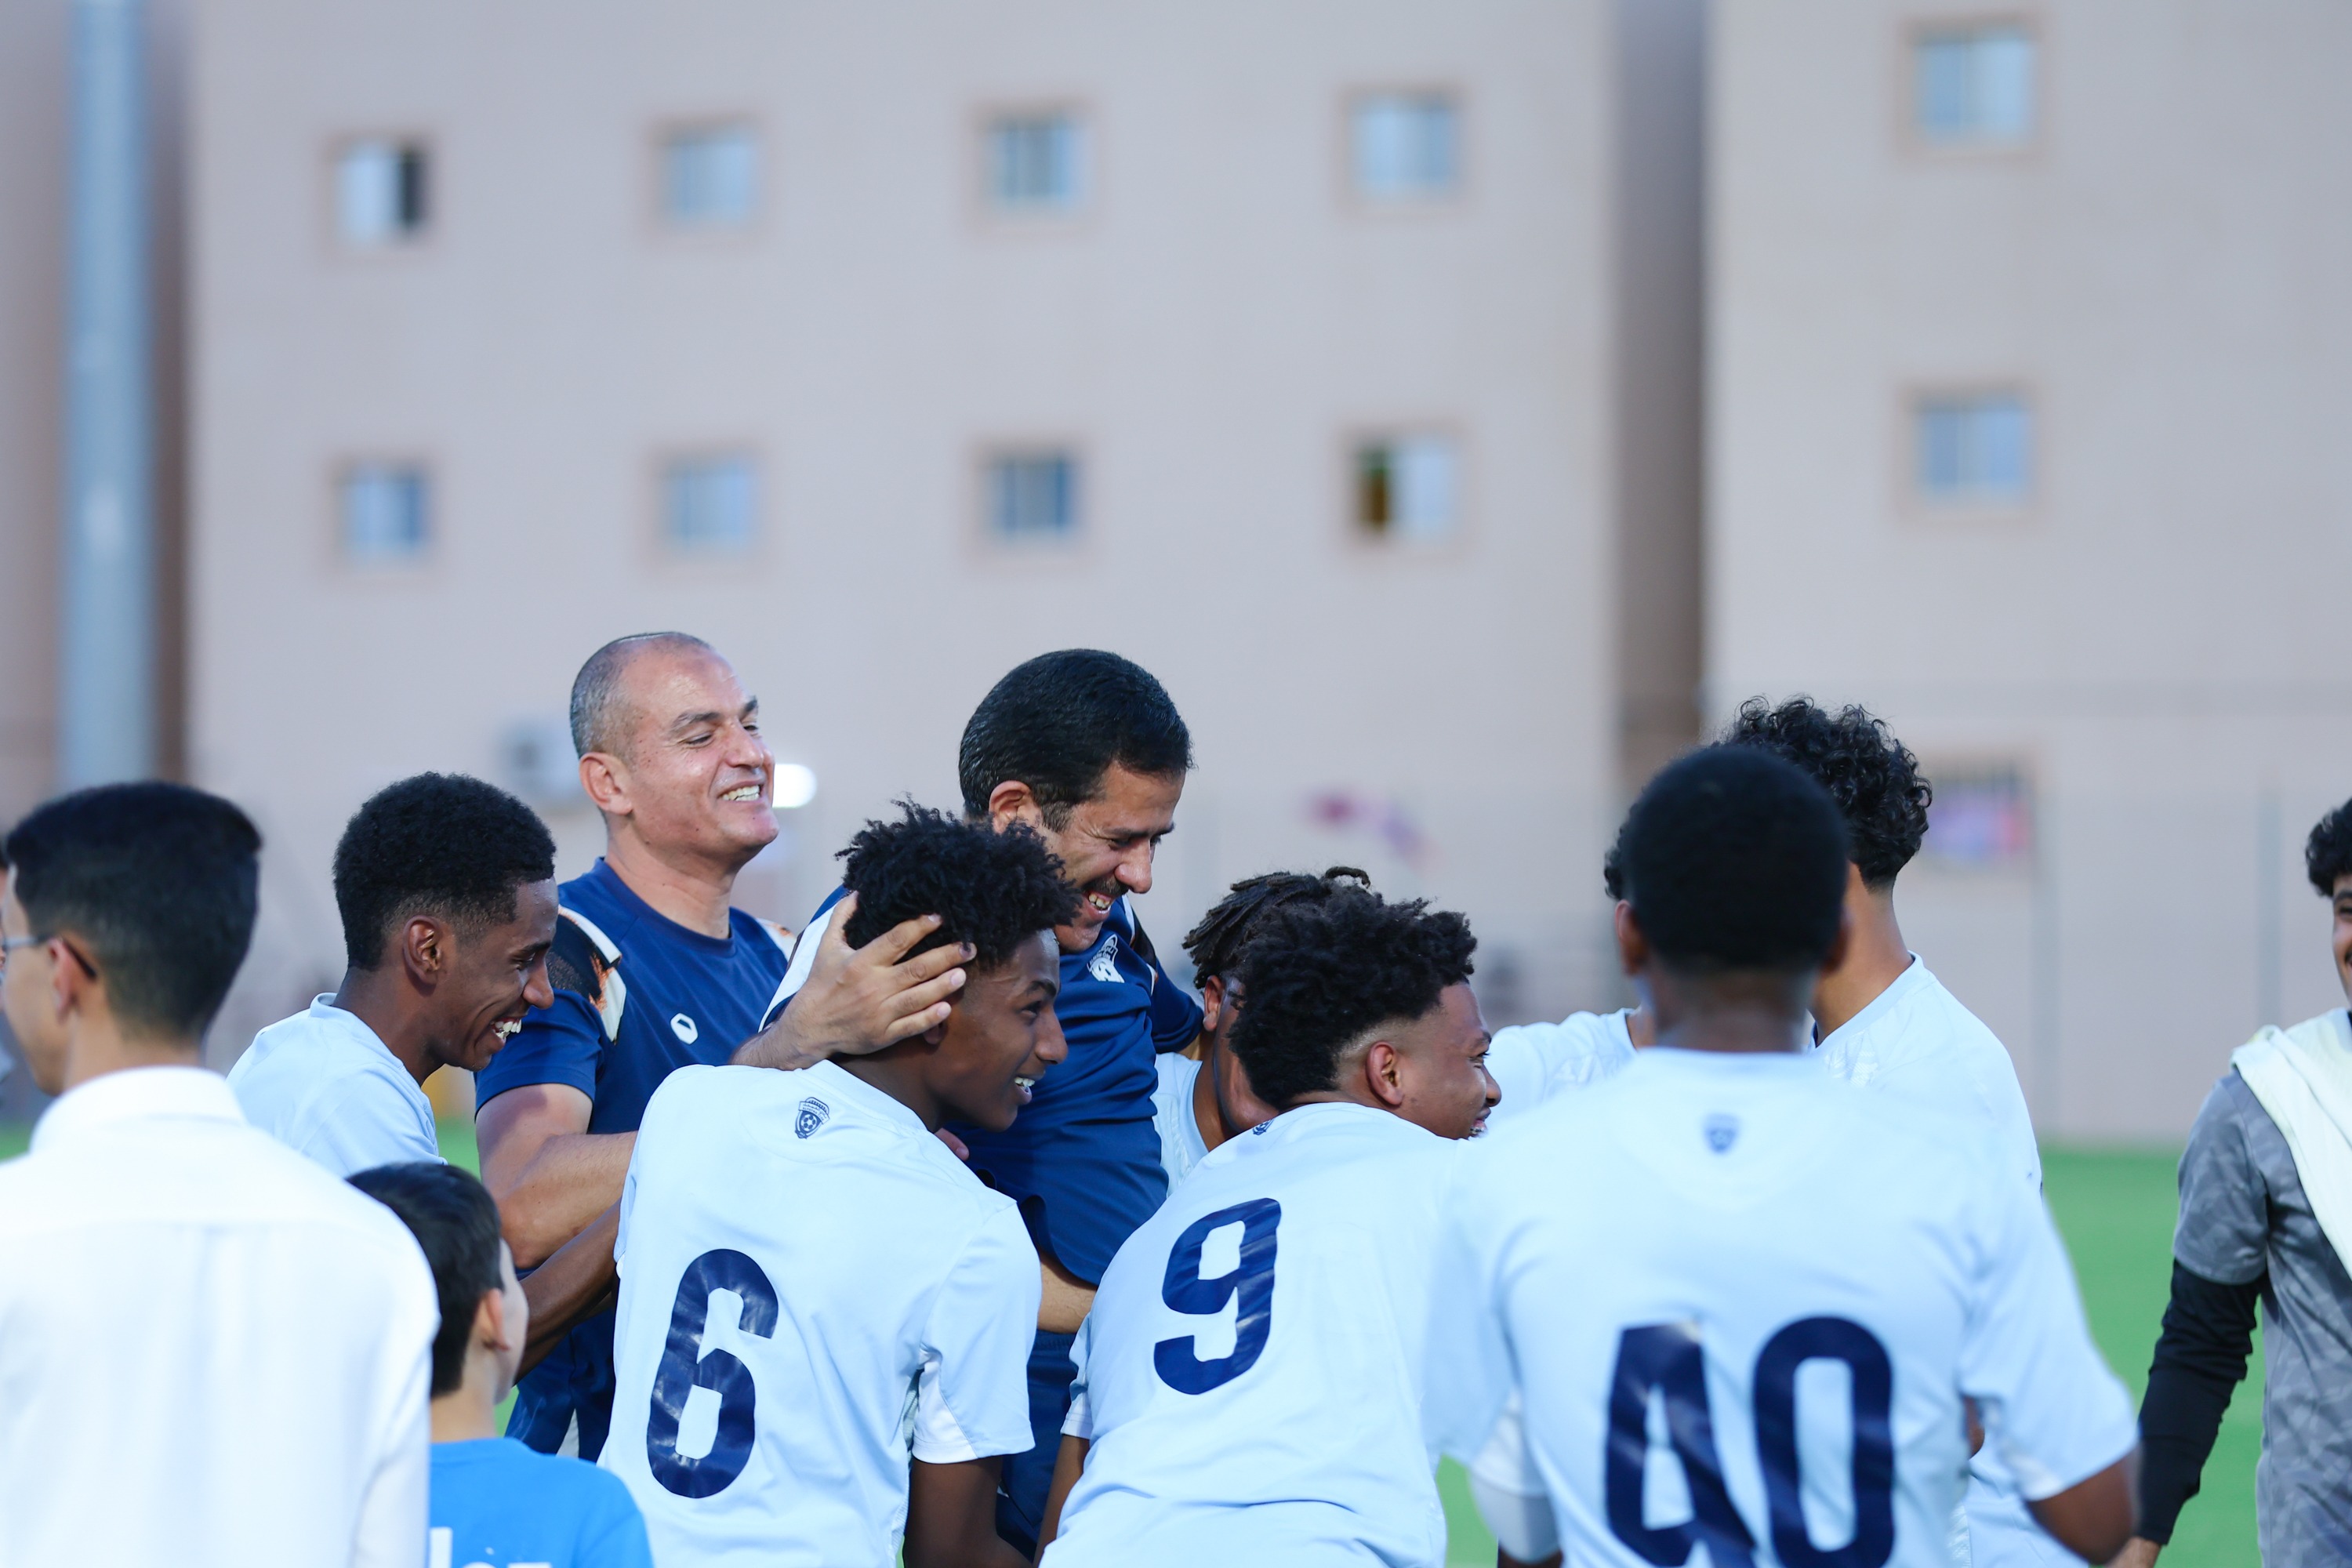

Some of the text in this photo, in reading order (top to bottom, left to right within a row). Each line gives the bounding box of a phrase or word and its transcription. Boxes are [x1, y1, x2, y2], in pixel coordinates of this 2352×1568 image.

[646, 1248, 779, 1498] 6
[1153, 1198, 1281, 1395] 9
[1604, 1316, 1894, 1568] 40
